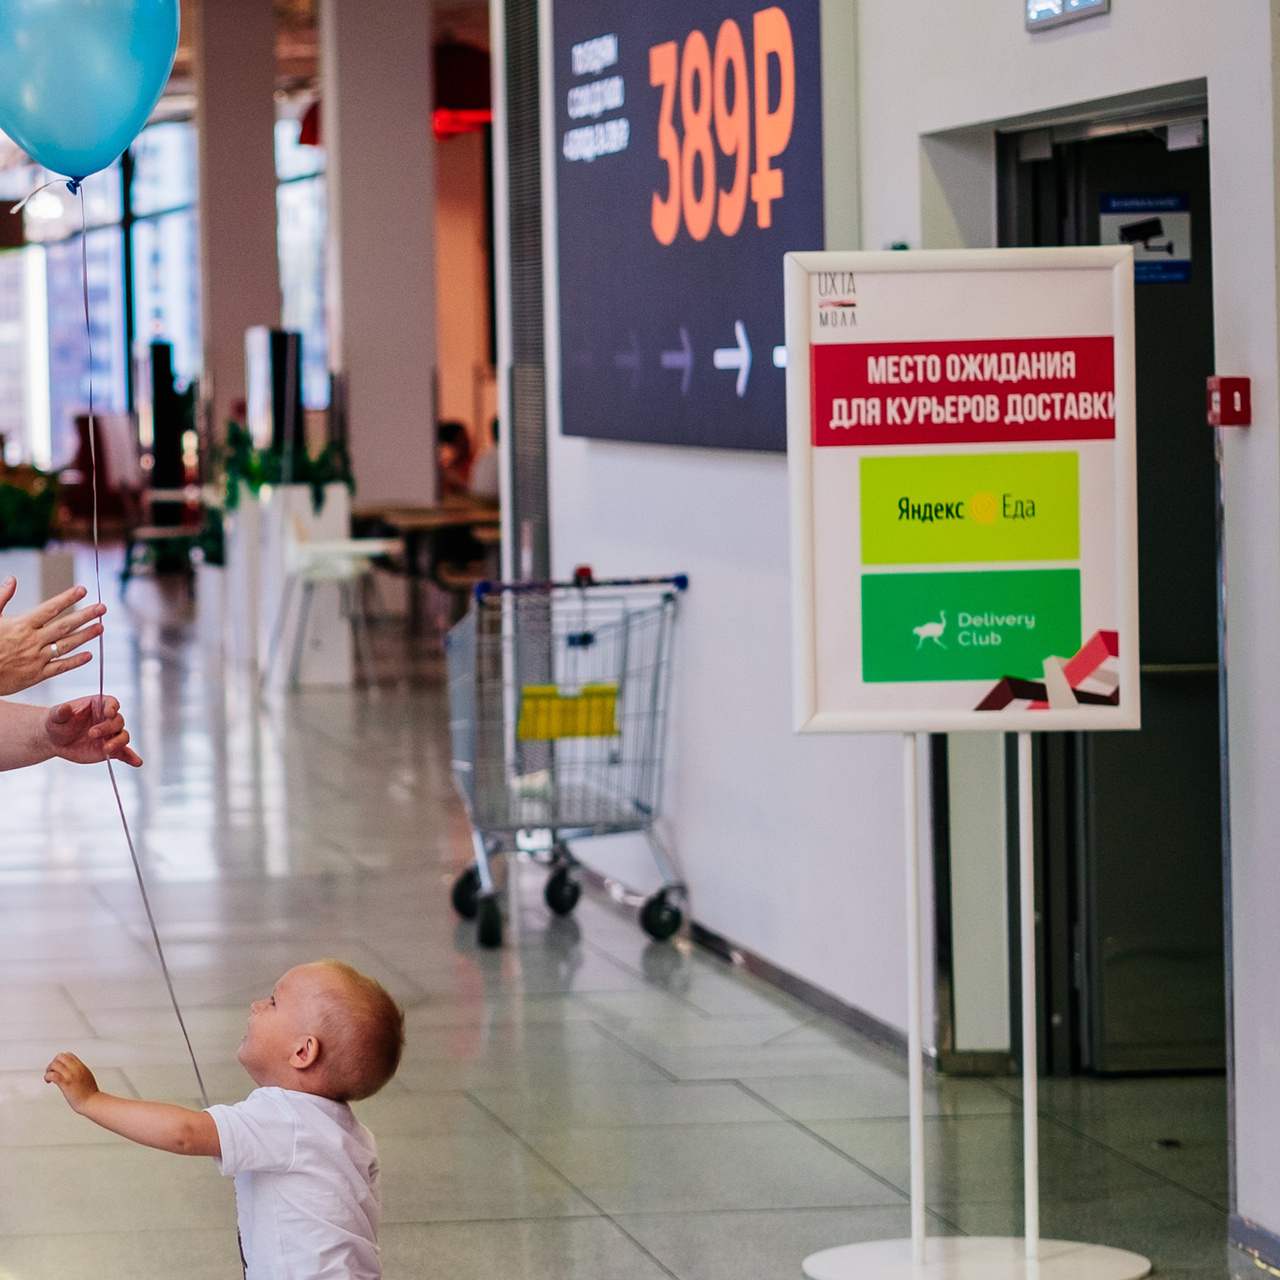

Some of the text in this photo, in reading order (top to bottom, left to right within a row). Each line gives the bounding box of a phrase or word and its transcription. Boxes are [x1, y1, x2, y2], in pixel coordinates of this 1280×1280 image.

[867, 351, 1076, 385] МЕСТО ОЖИДАНИЯ
[829, 397, 881, 430] ДЛЯ
[886, 394, 1000, 426] КУРЬЕРОВ
[898, 493, 1036, 522] Яндекс Еда
[957, 612, 1036, 629] Delivery
[957, 631, 1002, 646] Club
